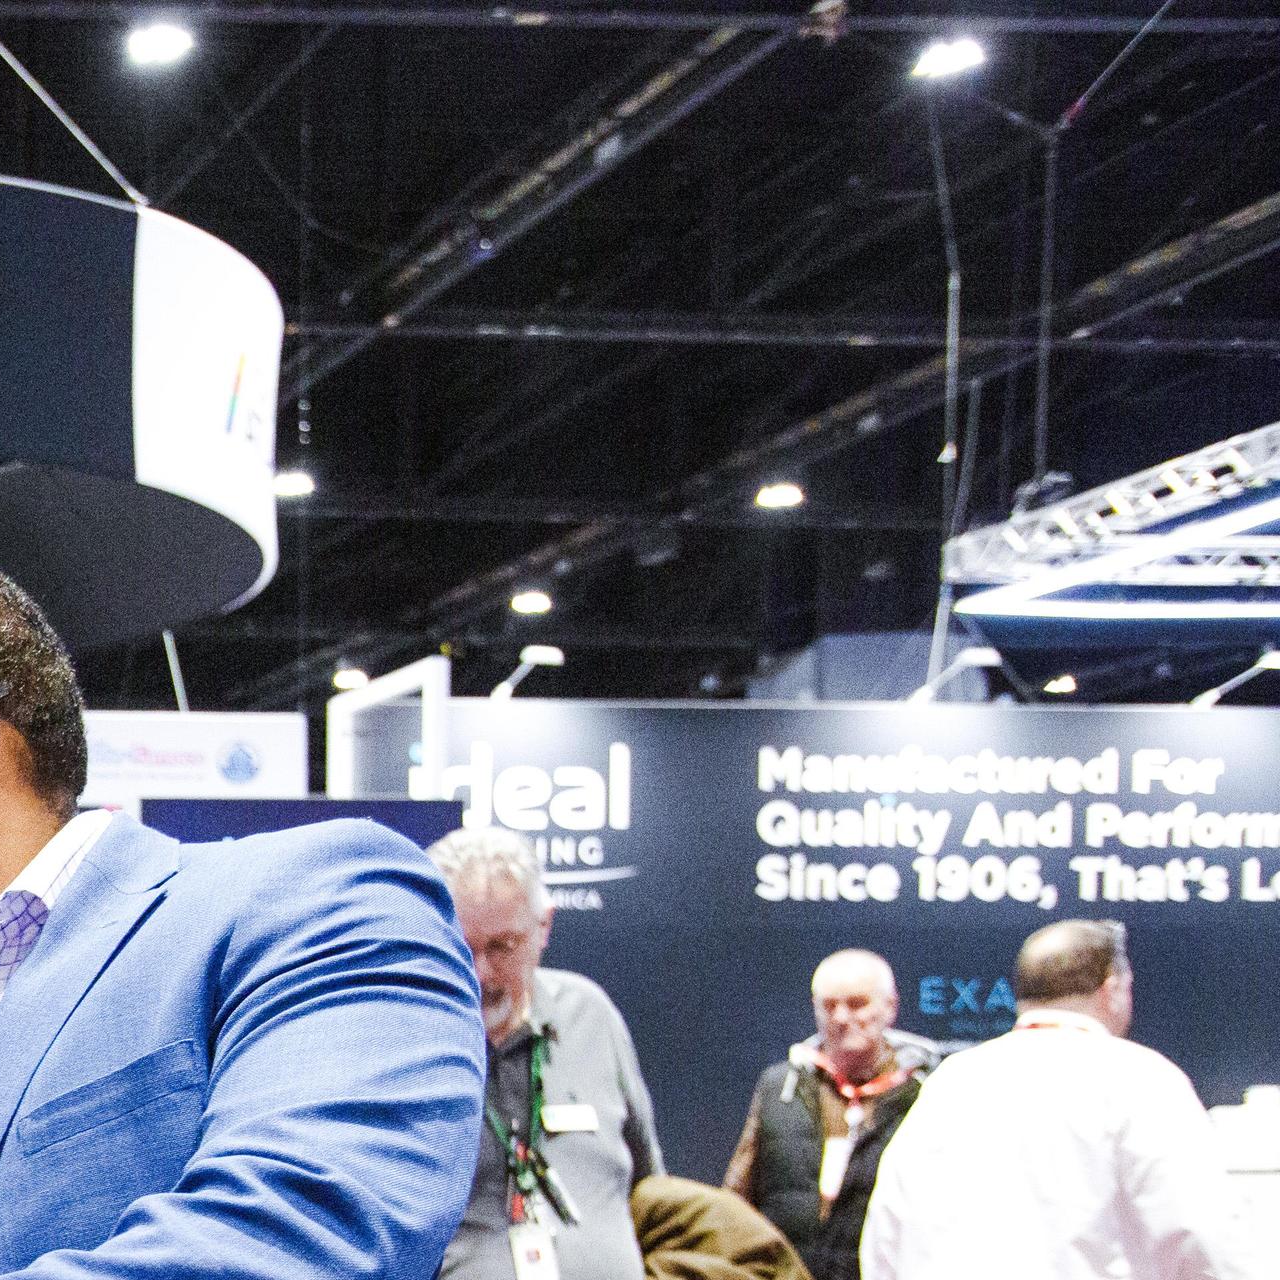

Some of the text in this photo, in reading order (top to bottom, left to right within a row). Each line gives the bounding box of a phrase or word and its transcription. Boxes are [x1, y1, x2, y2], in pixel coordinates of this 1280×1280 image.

[757, 744, 1225, 794] Manufactured For
[756, 792, 952, 856] Quality
[961, 800, 1073, 848] And
[755, 854, 902, 902] Since
[912, 854, 1058, 910] 1906,
[1068, 854, 1230, 903] That's
[919, 975, 1017, 1015] EXA
